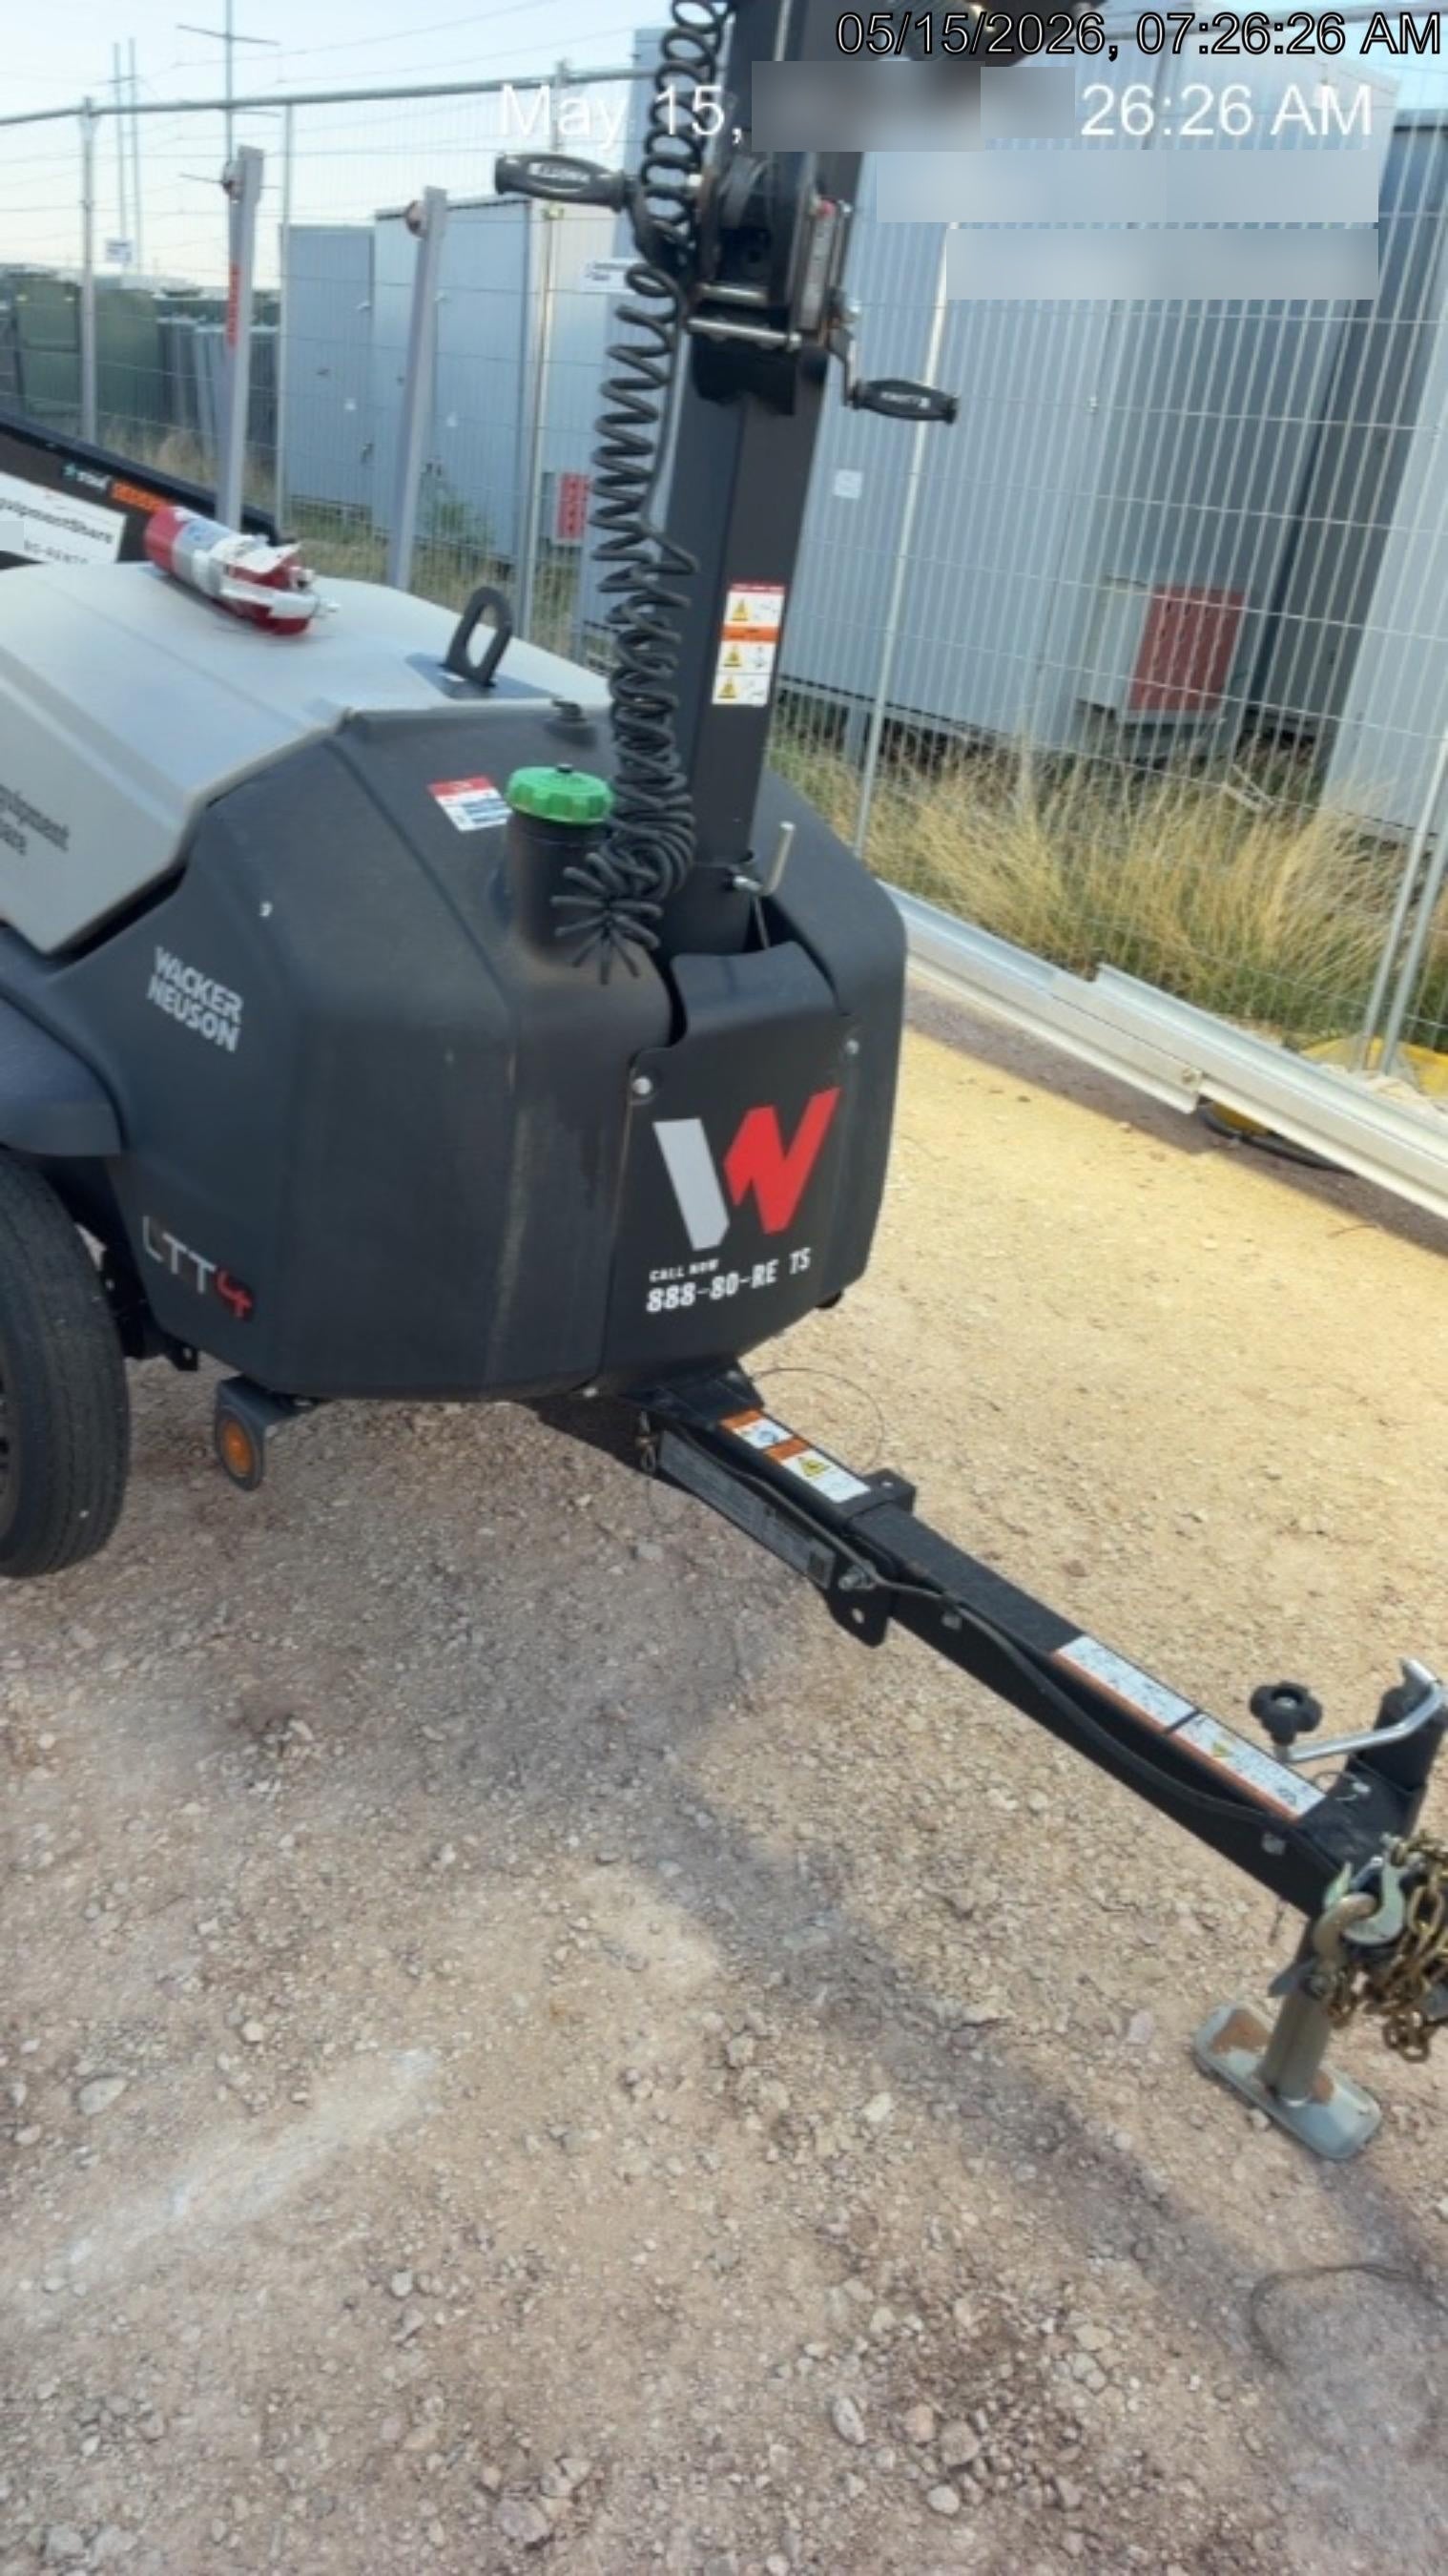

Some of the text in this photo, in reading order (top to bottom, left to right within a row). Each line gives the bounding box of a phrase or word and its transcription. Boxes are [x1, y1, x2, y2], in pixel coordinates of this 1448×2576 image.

[147, 974, 239, 1054] NEUSON
[155, 945, 244, 1024] WACKER
[142, 1215, 253, 1319] LTT4
[649, 1265, 685, 1283] CALL
